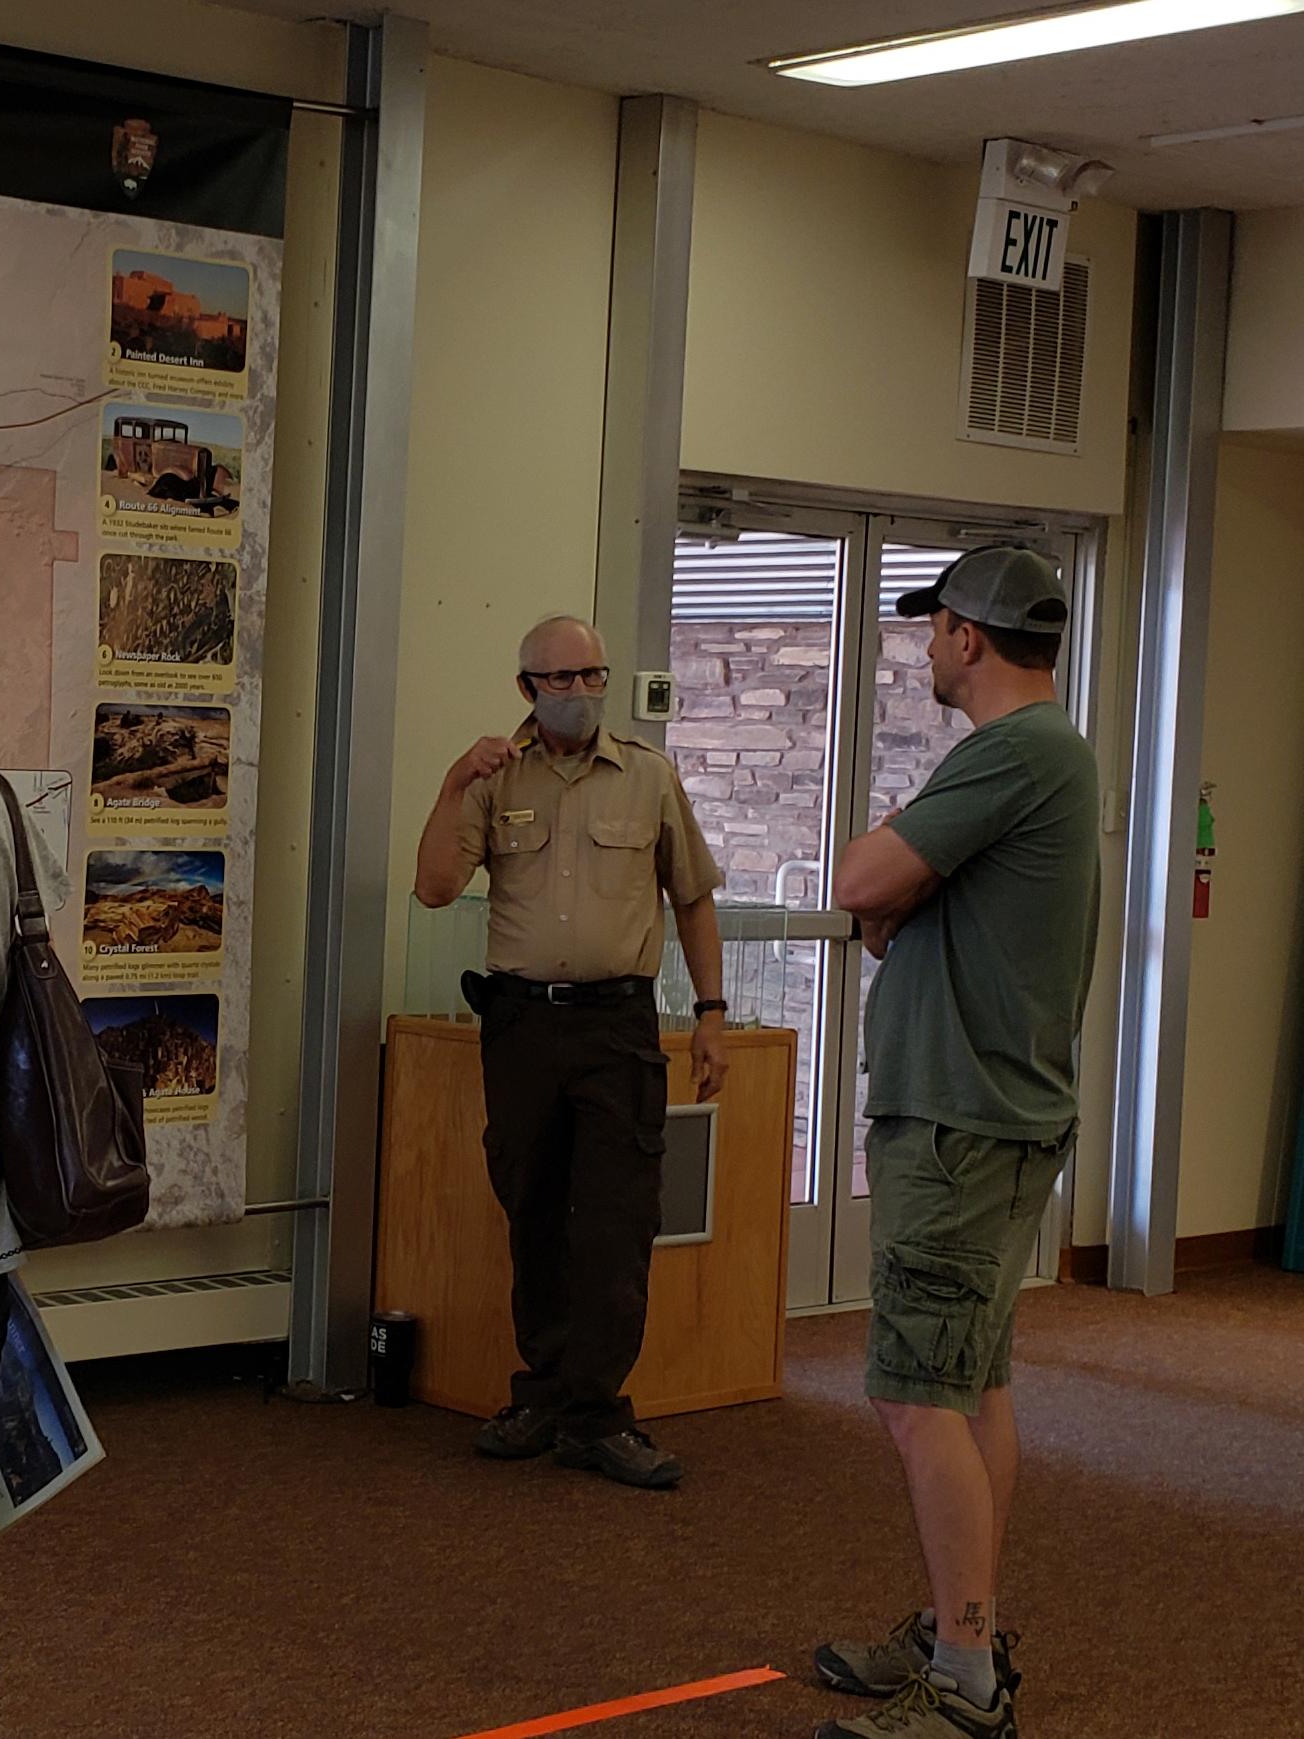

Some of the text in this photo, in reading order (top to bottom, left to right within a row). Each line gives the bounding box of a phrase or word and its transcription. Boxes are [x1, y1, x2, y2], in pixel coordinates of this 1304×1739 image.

[1000, 210, 1058, 280] EXIT
[126, 349, 204, 367] Painted Desert Inn
[119, 501, 201, 517] Route 66 Alignment
[125, 520, 158, 530] Studebaker
[207, 527, 223, 535] Route
[129, 531, 154, 540] through
[116, 650, 181, 663] Newspaper Rock
[107, 798, 160, 809] Agate Bridge
[85, 946, 92, 954] 10
[99, 944, 158, 956] Crystal Forest
[174, 1087, 200, 1095] House
[371, 1326, 387, 1340] AS
[371, 1338, 386, 1353] DE
